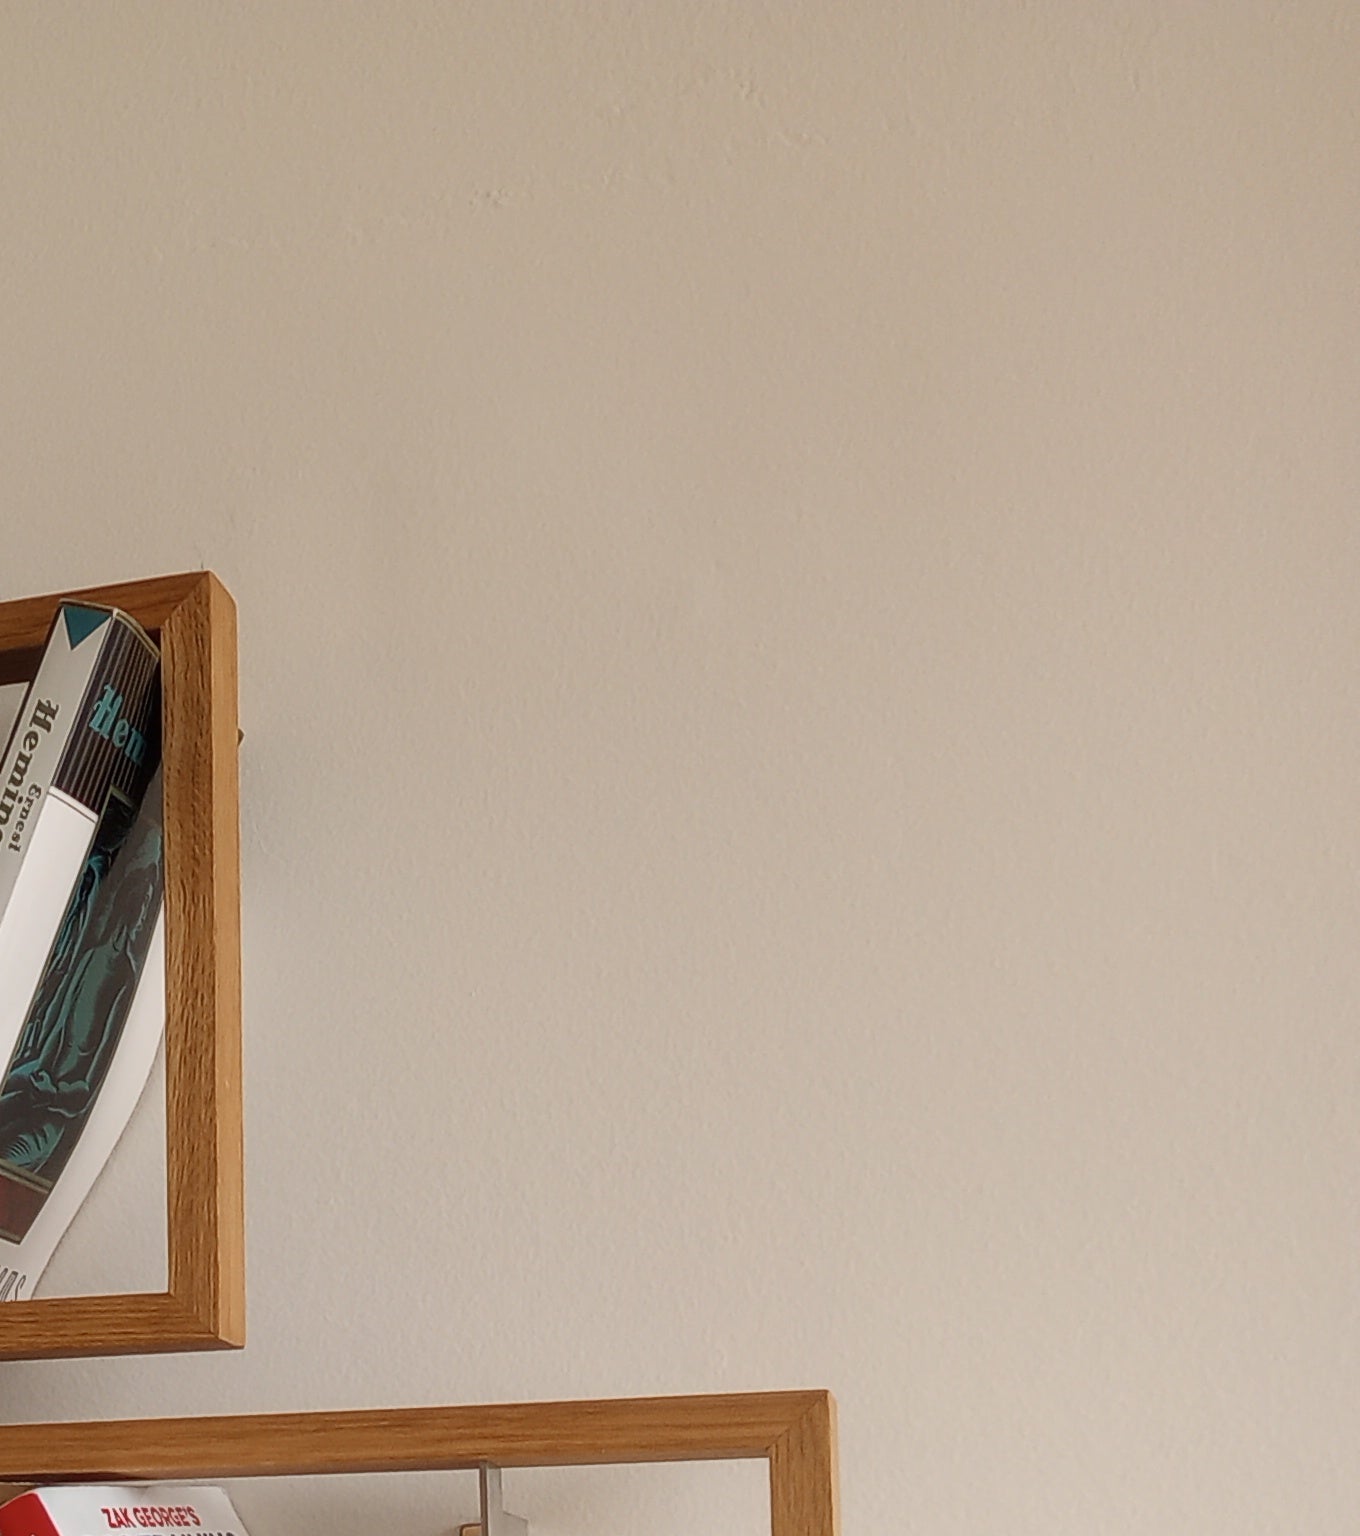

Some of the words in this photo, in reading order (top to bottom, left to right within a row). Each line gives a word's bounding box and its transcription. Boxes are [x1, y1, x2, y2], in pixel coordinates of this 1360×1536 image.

[8, 784, 42, 853] Ernest
[101, 1507, 136, 1529] ZAK
[133, 1505, 202, 1528] GEORGE'S
